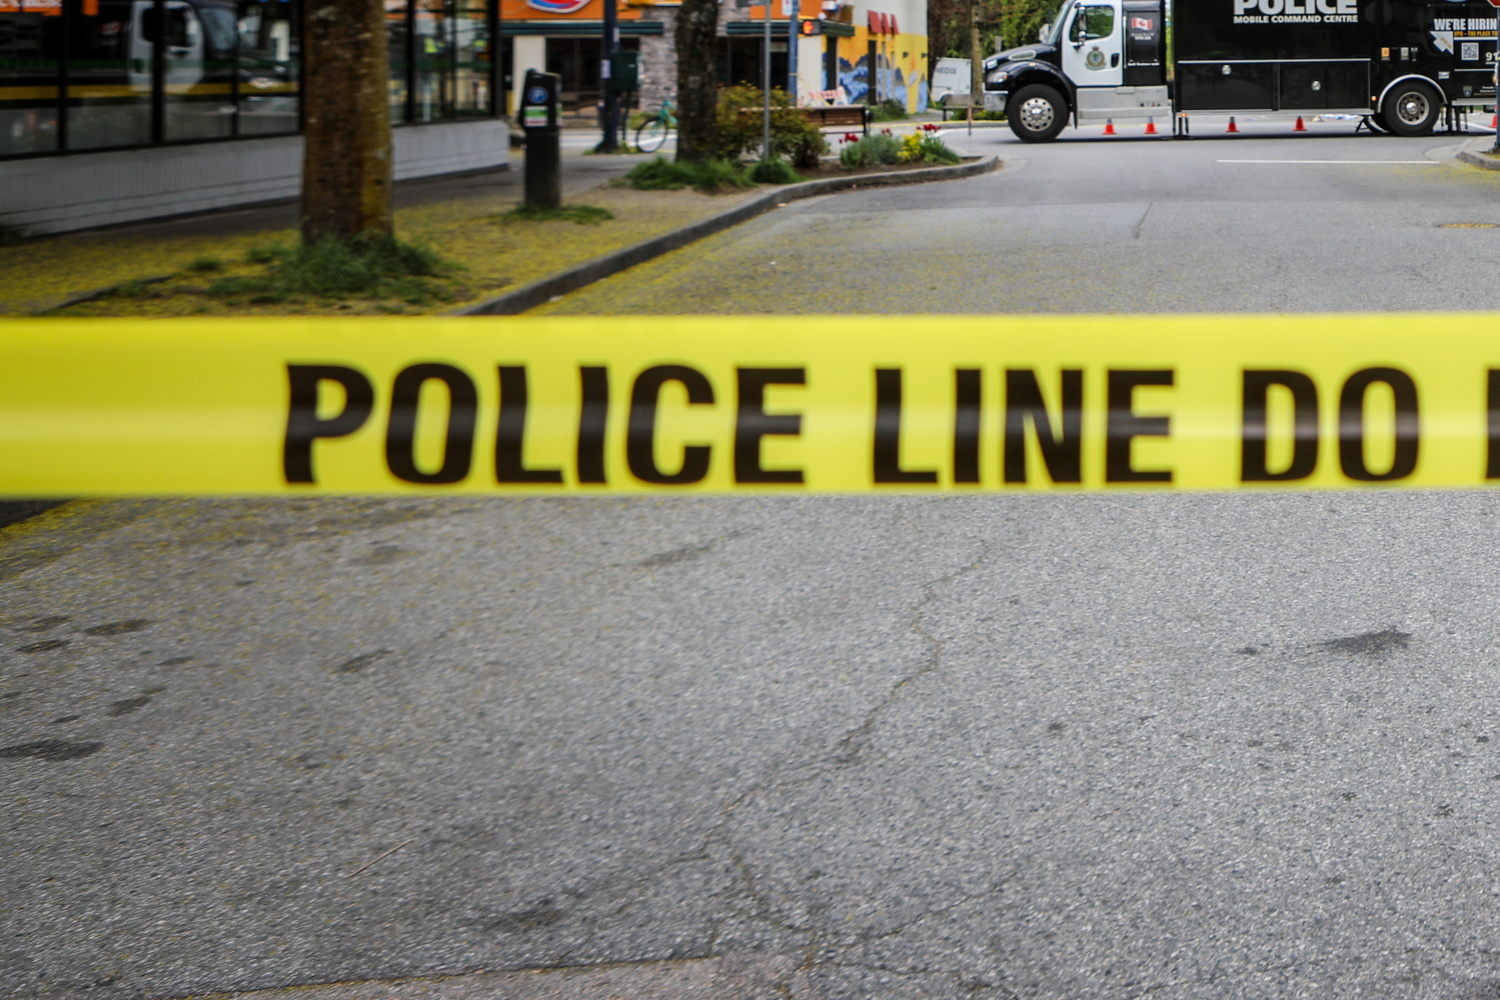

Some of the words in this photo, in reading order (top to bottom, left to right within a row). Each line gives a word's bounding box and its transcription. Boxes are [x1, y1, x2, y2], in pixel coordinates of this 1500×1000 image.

[1233, 15, 1269, 24] MOBILE
[1271, 15, 1322, 23] COMMAND
[1433, 18, 1466, 30] WE'RE
[1467, 18, 1498, 30] HIRIN
[283, 362, 806, 486] POLICE
[871, 367, 1176, 485] LINE
[1239, 366, 1423, 484] DO
